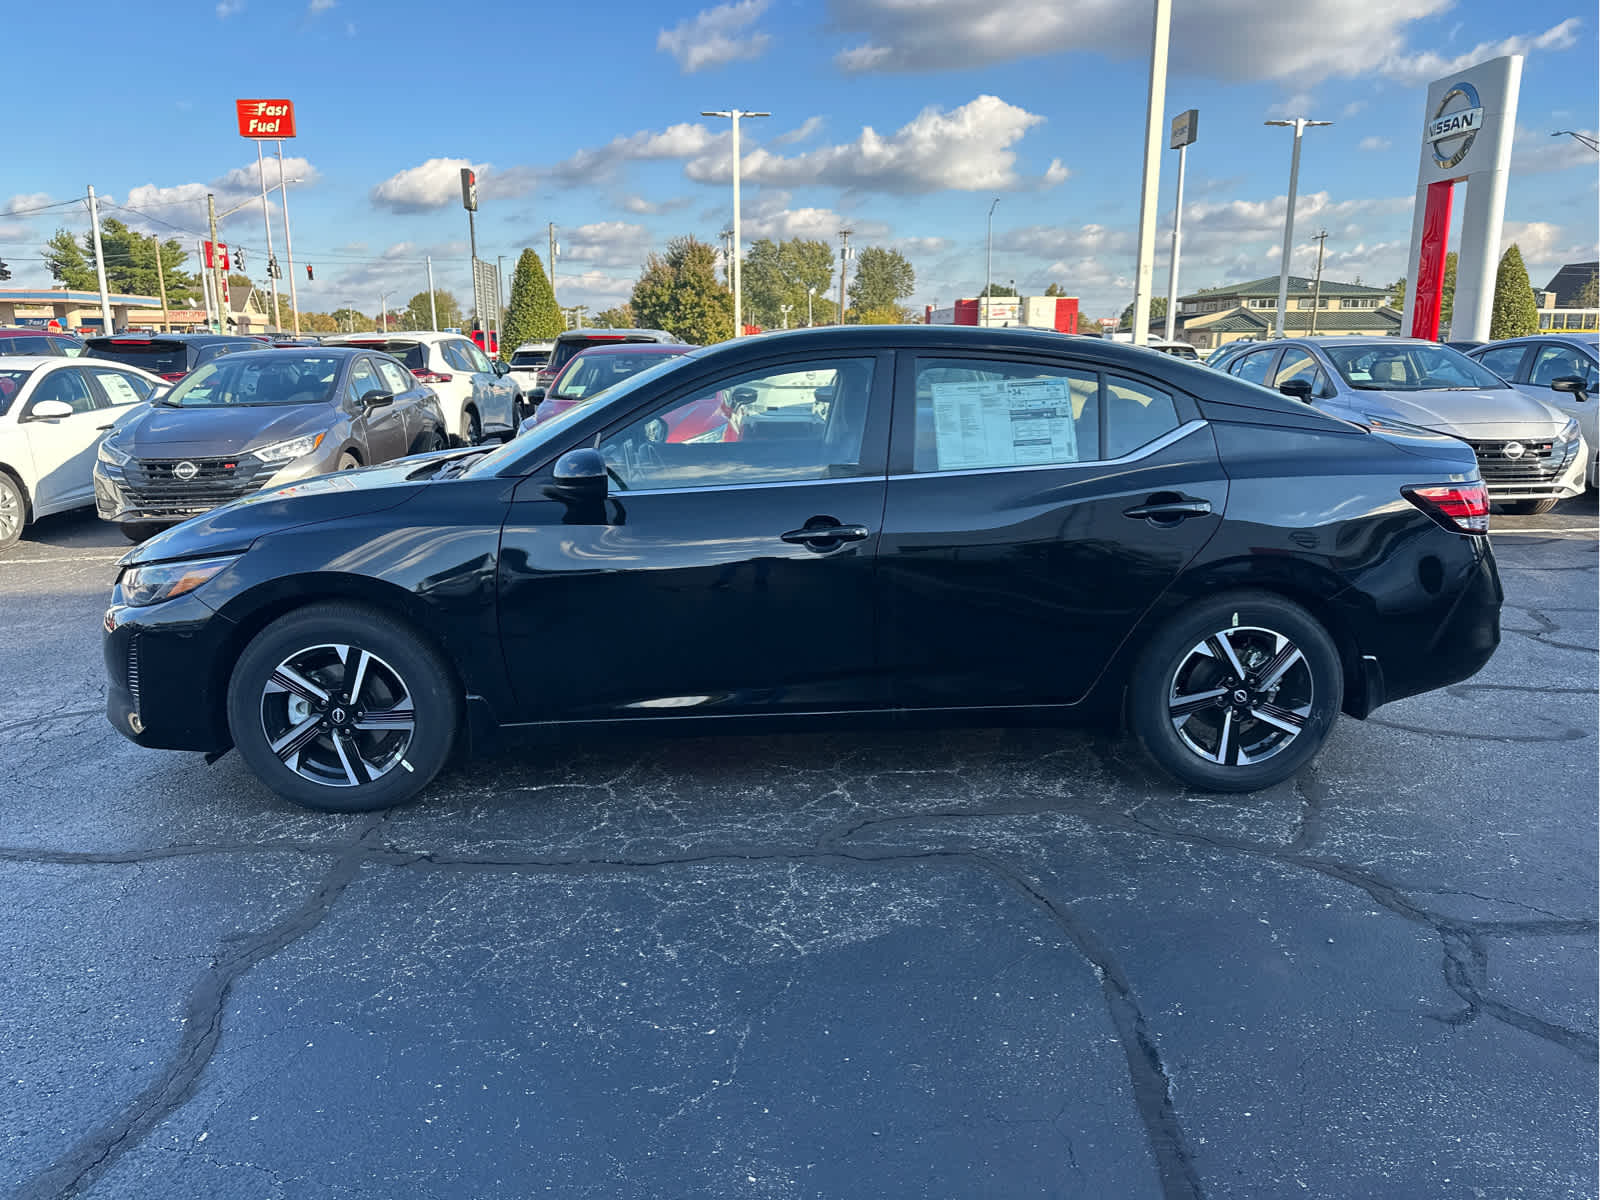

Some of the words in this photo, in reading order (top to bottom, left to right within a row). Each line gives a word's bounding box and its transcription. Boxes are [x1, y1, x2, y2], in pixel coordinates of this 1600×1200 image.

[257, 102, 288, 117] Fast
[248, 118, 281, 133] Fuel
[1429, 112, 1474, 137] NISSAN
